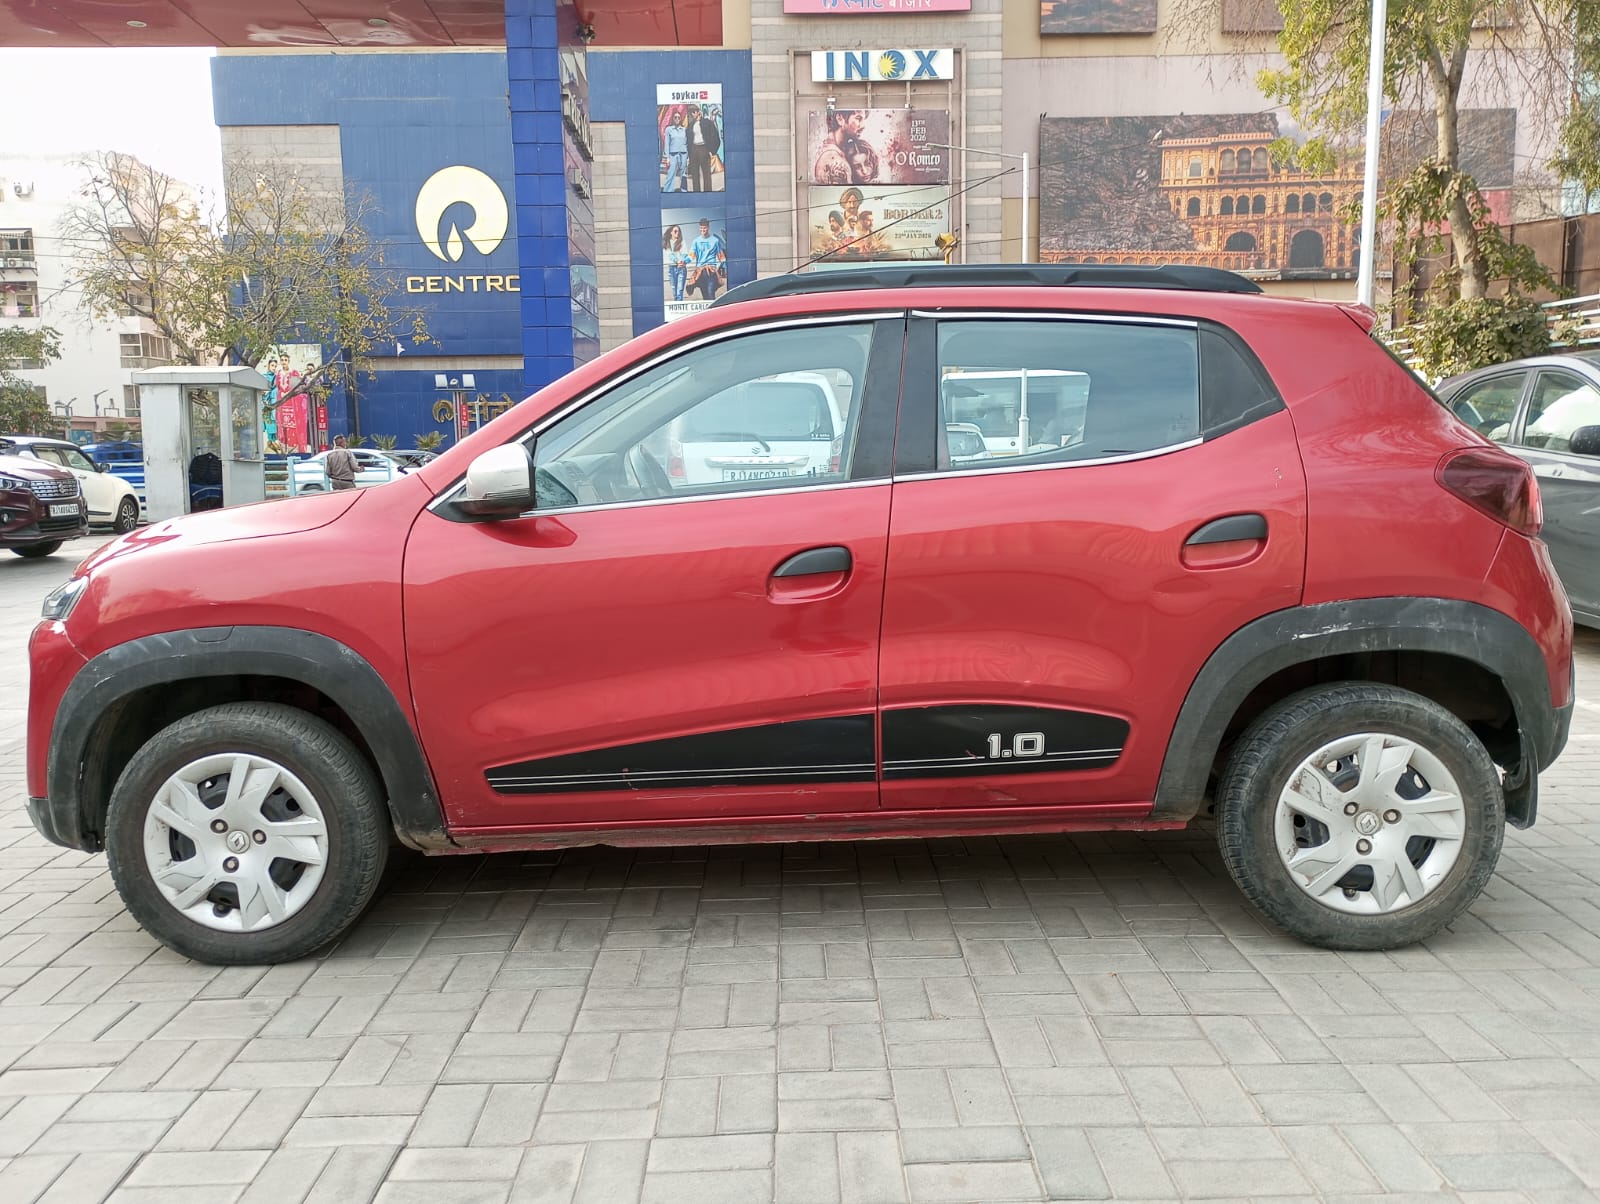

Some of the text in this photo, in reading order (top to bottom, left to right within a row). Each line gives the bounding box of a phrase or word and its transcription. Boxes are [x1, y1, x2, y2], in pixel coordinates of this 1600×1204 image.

[826, 49, 939, 80] INOX
[671, 91, 699, 101] spykar
[987, 732, 1045, 758] 1.0
